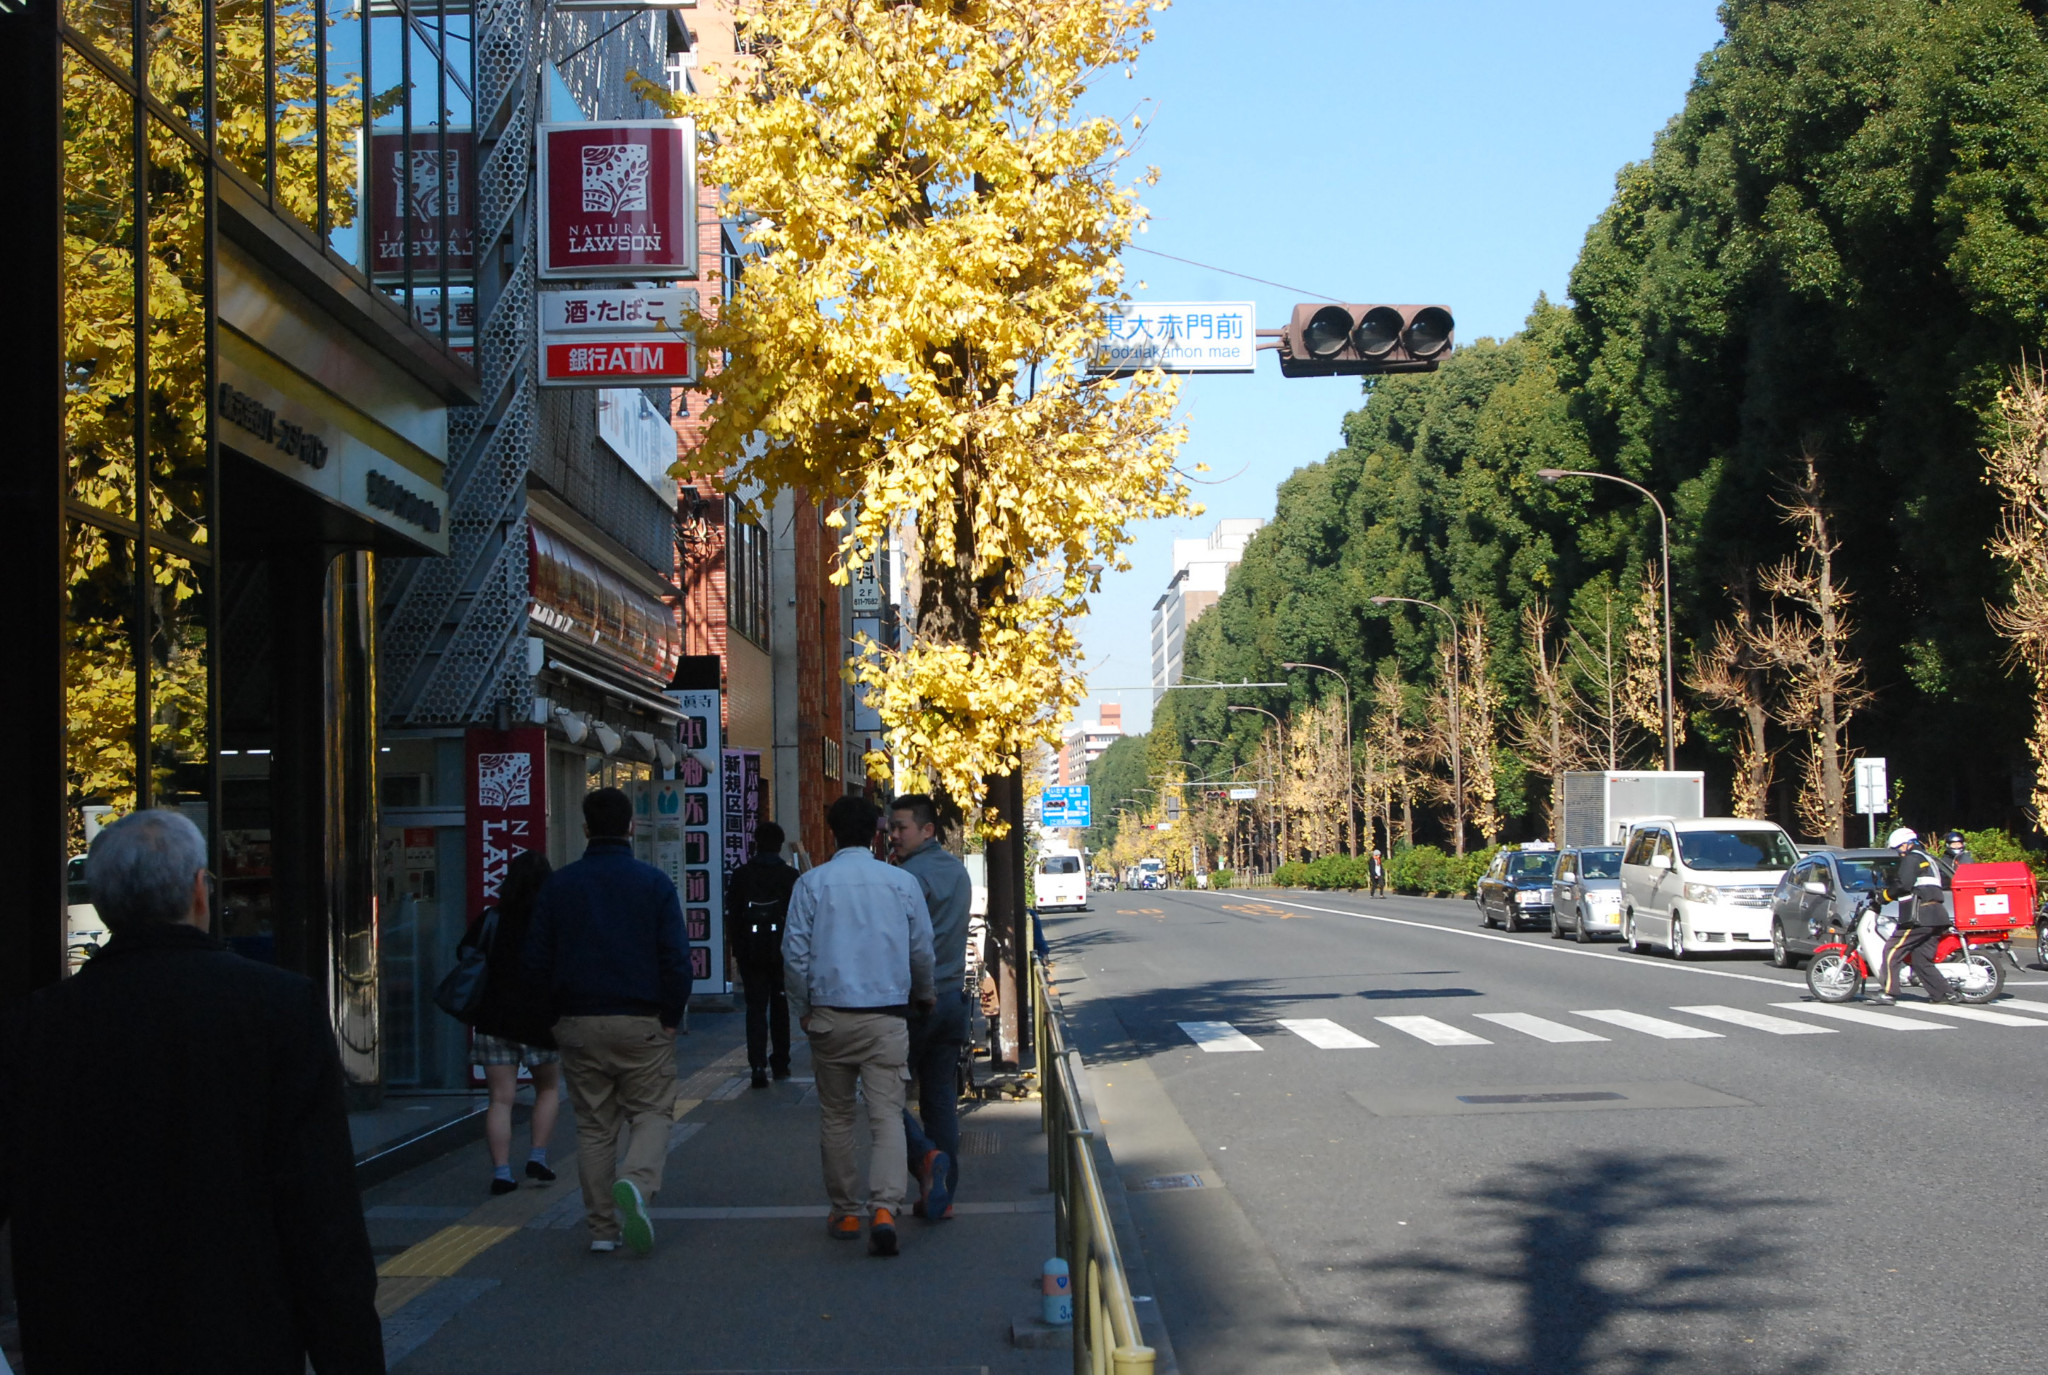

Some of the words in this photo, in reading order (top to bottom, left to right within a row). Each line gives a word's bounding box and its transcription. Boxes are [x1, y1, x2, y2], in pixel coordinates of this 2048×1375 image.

[569, 223, 662, 236] NATURAL
[568, 235, 662, 253] LAWSON
[1102, 313, 1243, 340] 東大赤門前
[568, 347, 664, 372] 銀行ATM
[1101, 344, 1202, 359] Todaiakamon
[1208, 347, 1241, 358] mae
